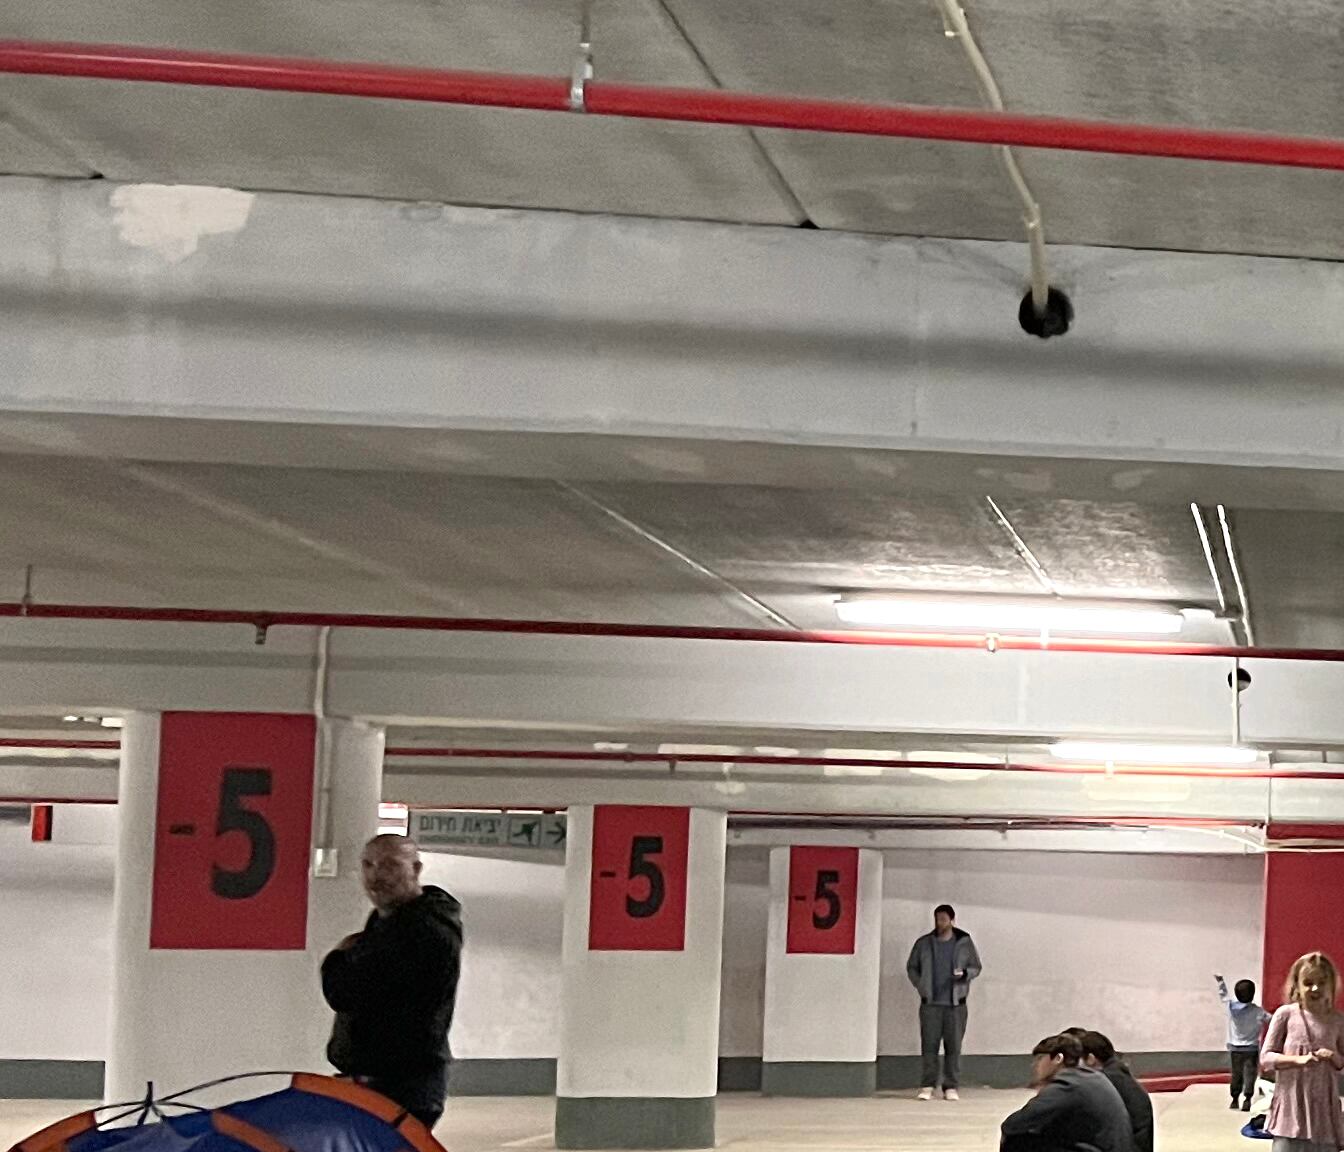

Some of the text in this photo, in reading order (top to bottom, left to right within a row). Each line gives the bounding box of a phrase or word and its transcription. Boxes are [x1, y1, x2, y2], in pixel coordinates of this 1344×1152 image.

[168, 767, 276, 899] -5
[599, 836, 665, 918] -5
[794, 869, 841, 930] -5
